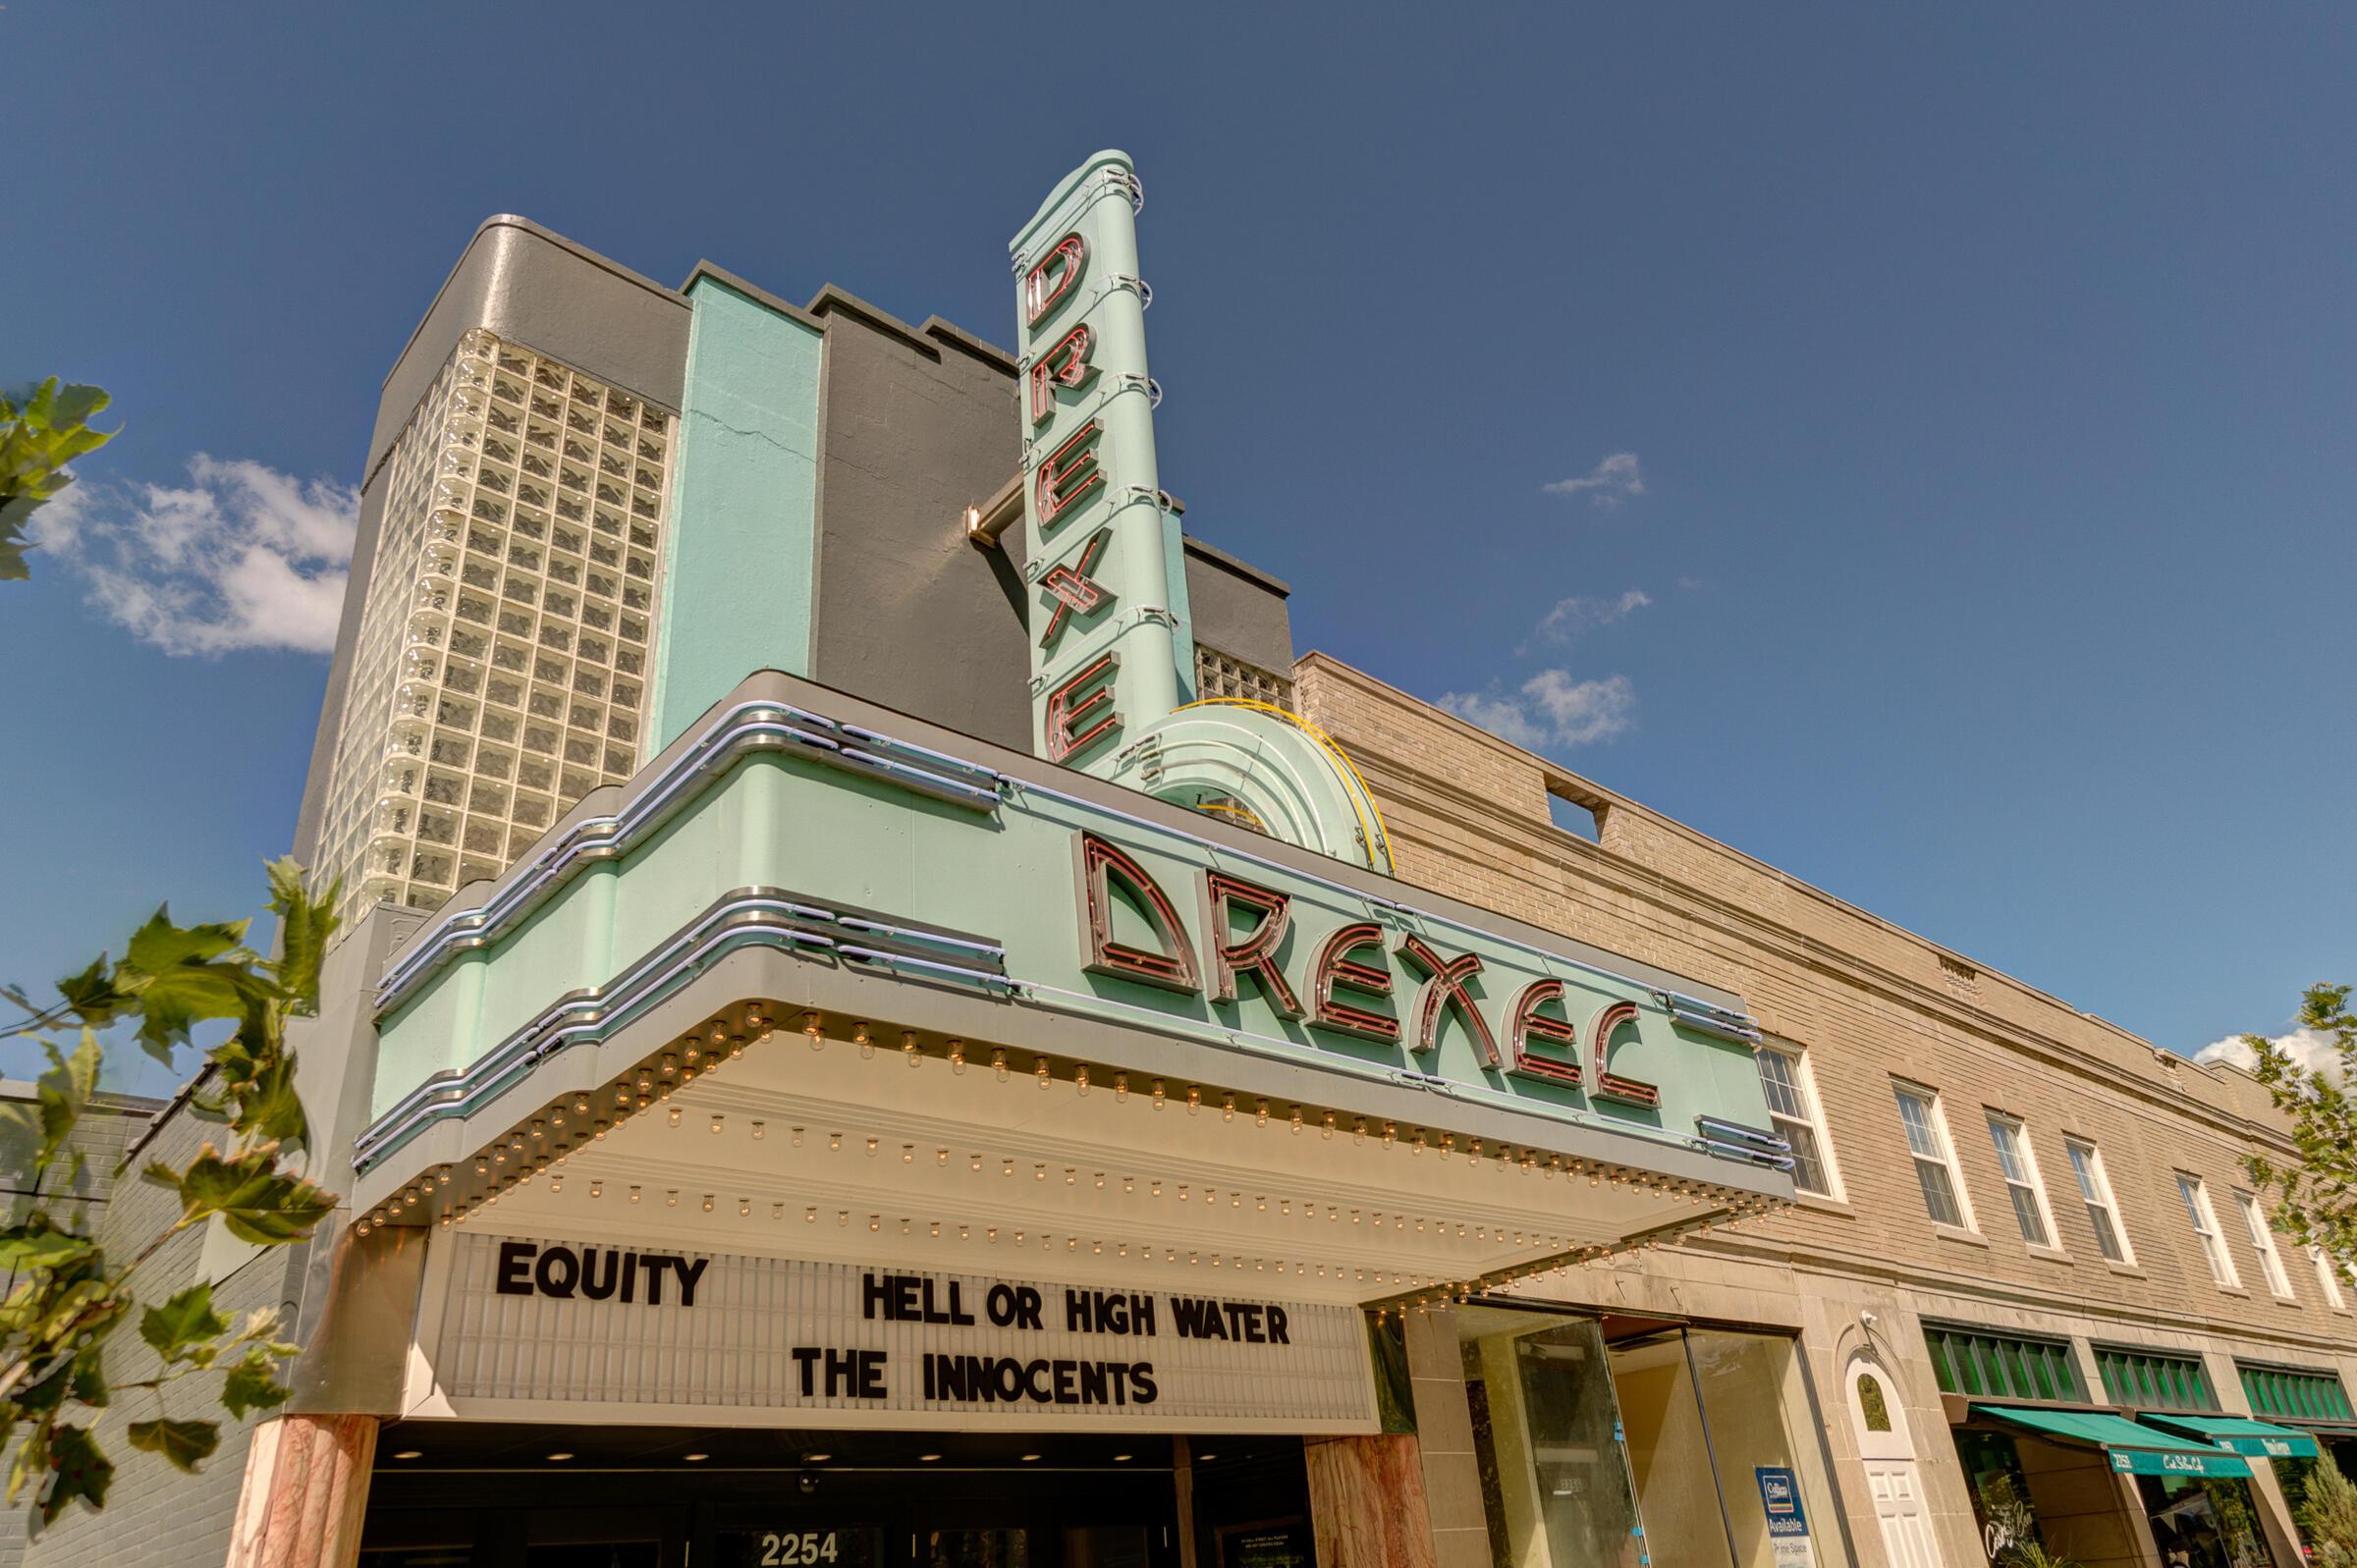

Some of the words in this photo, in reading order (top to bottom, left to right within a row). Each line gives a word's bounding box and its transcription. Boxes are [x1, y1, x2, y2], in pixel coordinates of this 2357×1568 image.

[1026, 231, 1124, 763] DREXE
[1071, 828, 1662, 1110] DREXEL
[496, 1241, 709, 1307] EQUITY
[862, 1272, 975, 1326] HELL
[986, 1283, 1044, 1330] OR
[1065, 1289, 1157, 1336] HIGH
[1170, 1297, 1290, 1345] WATER
[792, 1347, 888, 1399] THE
[922, 1353, 1158, 1406] INNOCENTS
[761, 1533, 838, 1566] 2254
[1769, 1518, 1802, 1533] Available
[1790, 1542, 1807, 1555] Space
